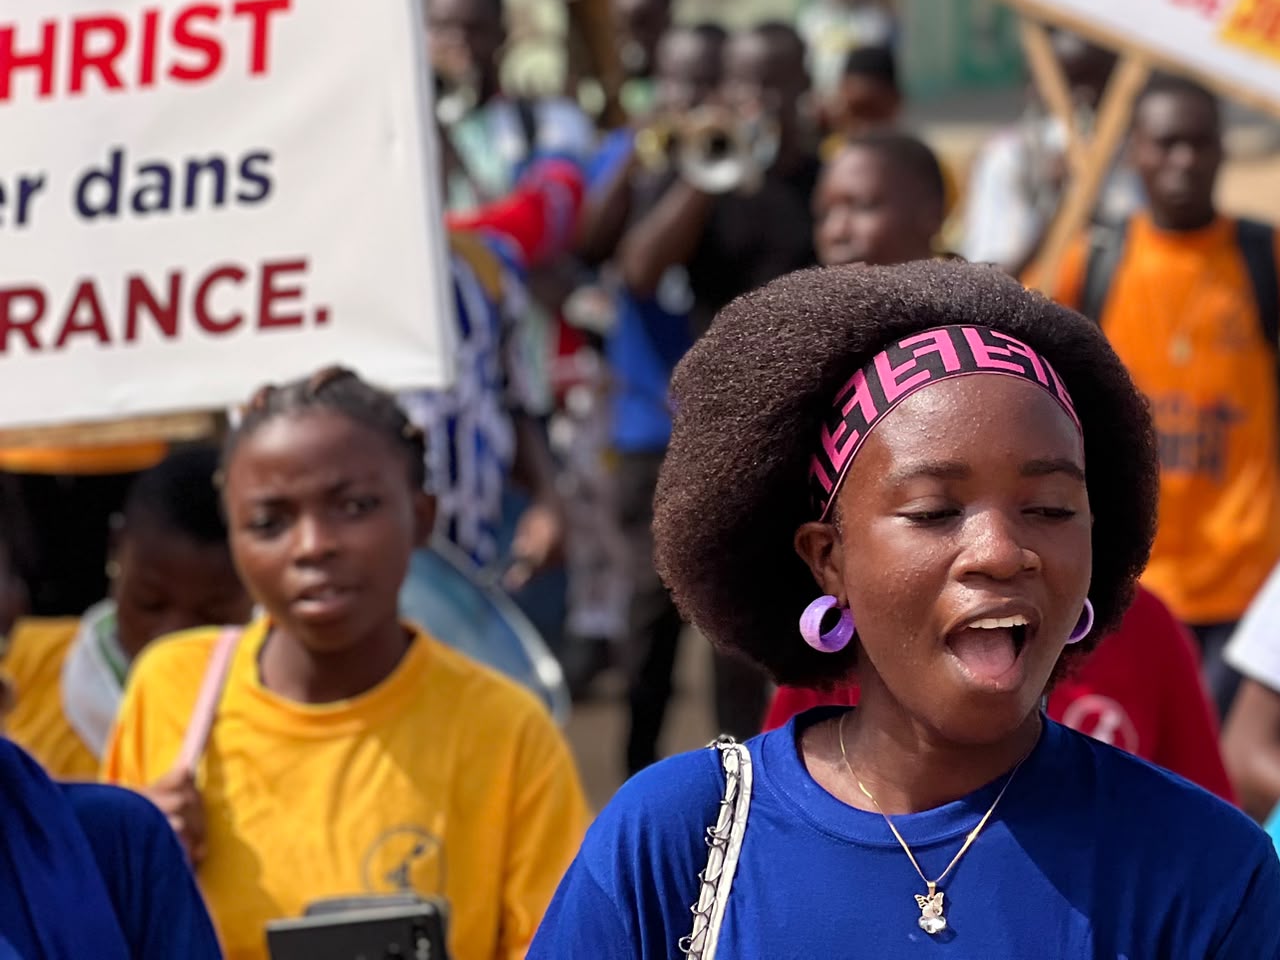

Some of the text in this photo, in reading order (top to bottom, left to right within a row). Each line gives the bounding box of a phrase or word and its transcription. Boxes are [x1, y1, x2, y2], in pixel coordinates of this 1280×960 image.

[0, 148, 273, 226] r dans
[0, 258, 330, 355] RANCE.
